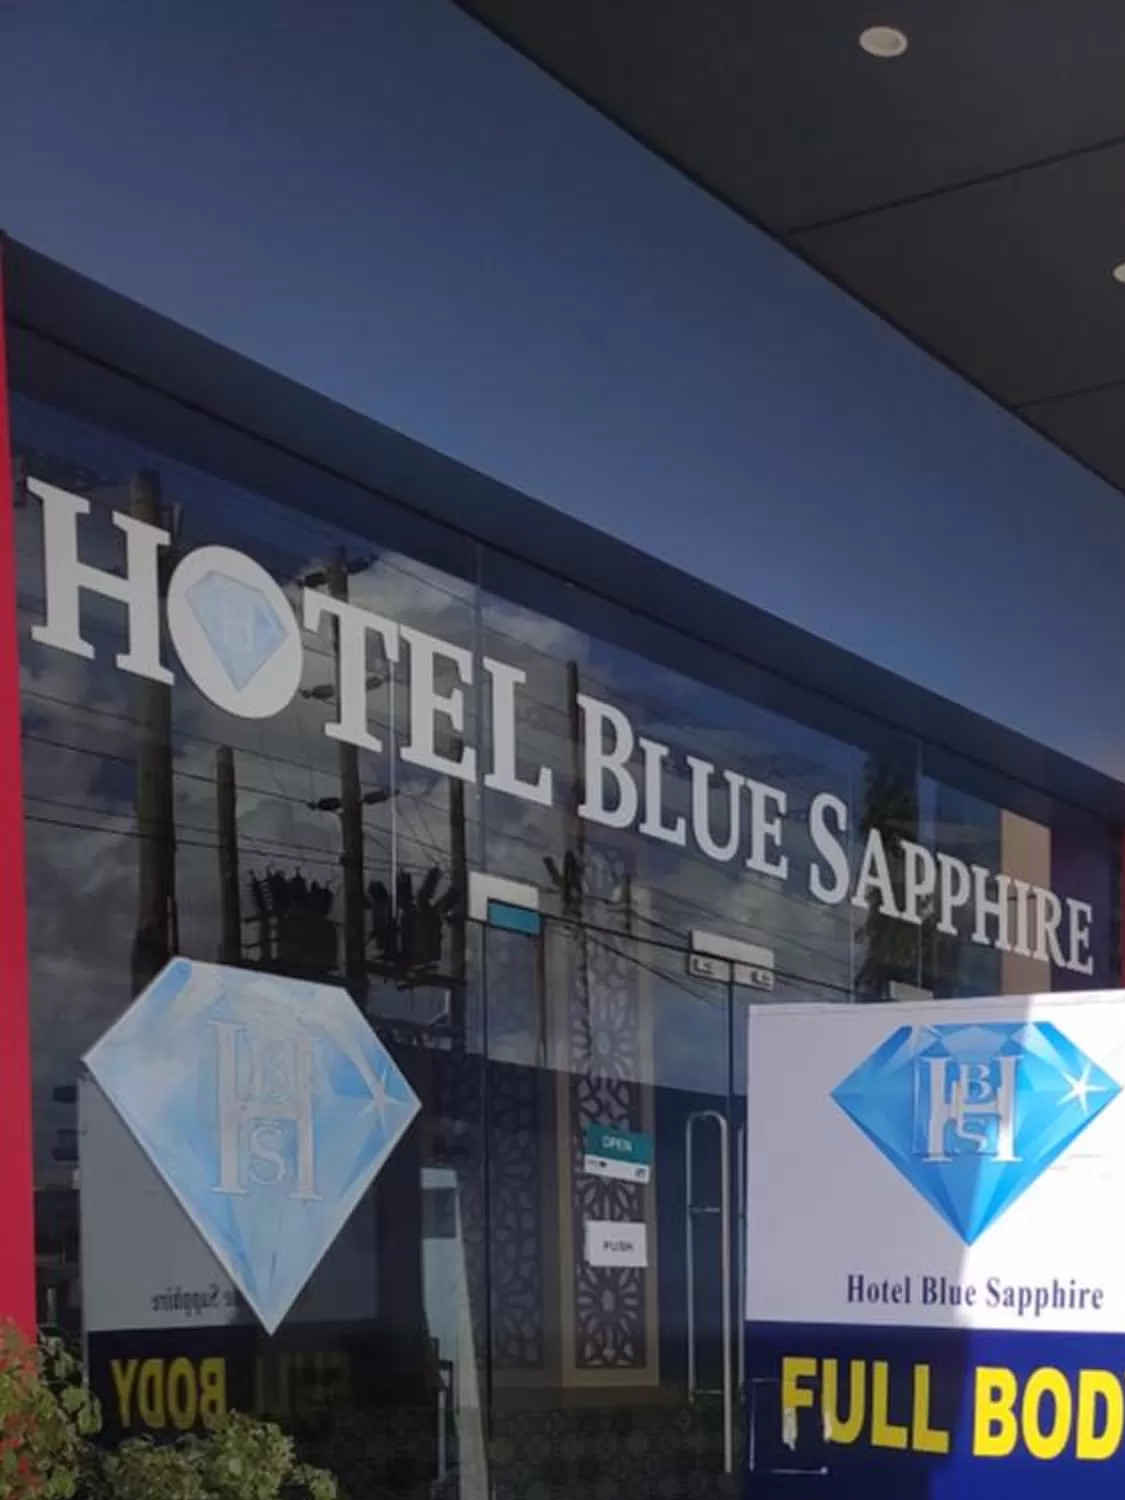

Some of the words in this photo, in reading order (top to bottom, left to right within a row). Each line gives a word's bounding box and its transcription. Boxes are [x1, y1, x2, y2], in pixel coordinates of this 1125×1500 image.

[27, 477, 553, 807] HOTEL
[577, 693, 788, 881] BLUE
[807, 791, 1094, 976] SAPPHIRE
[602, 1135, 633, 1152] OPEN
[847, 1274, 912, 1304] Hotel
[922, 1276, 977, 1307] Blue
[985, 1276, 1105, 1317] Sapphire
[781, 1356, 949, 1454] FULL
